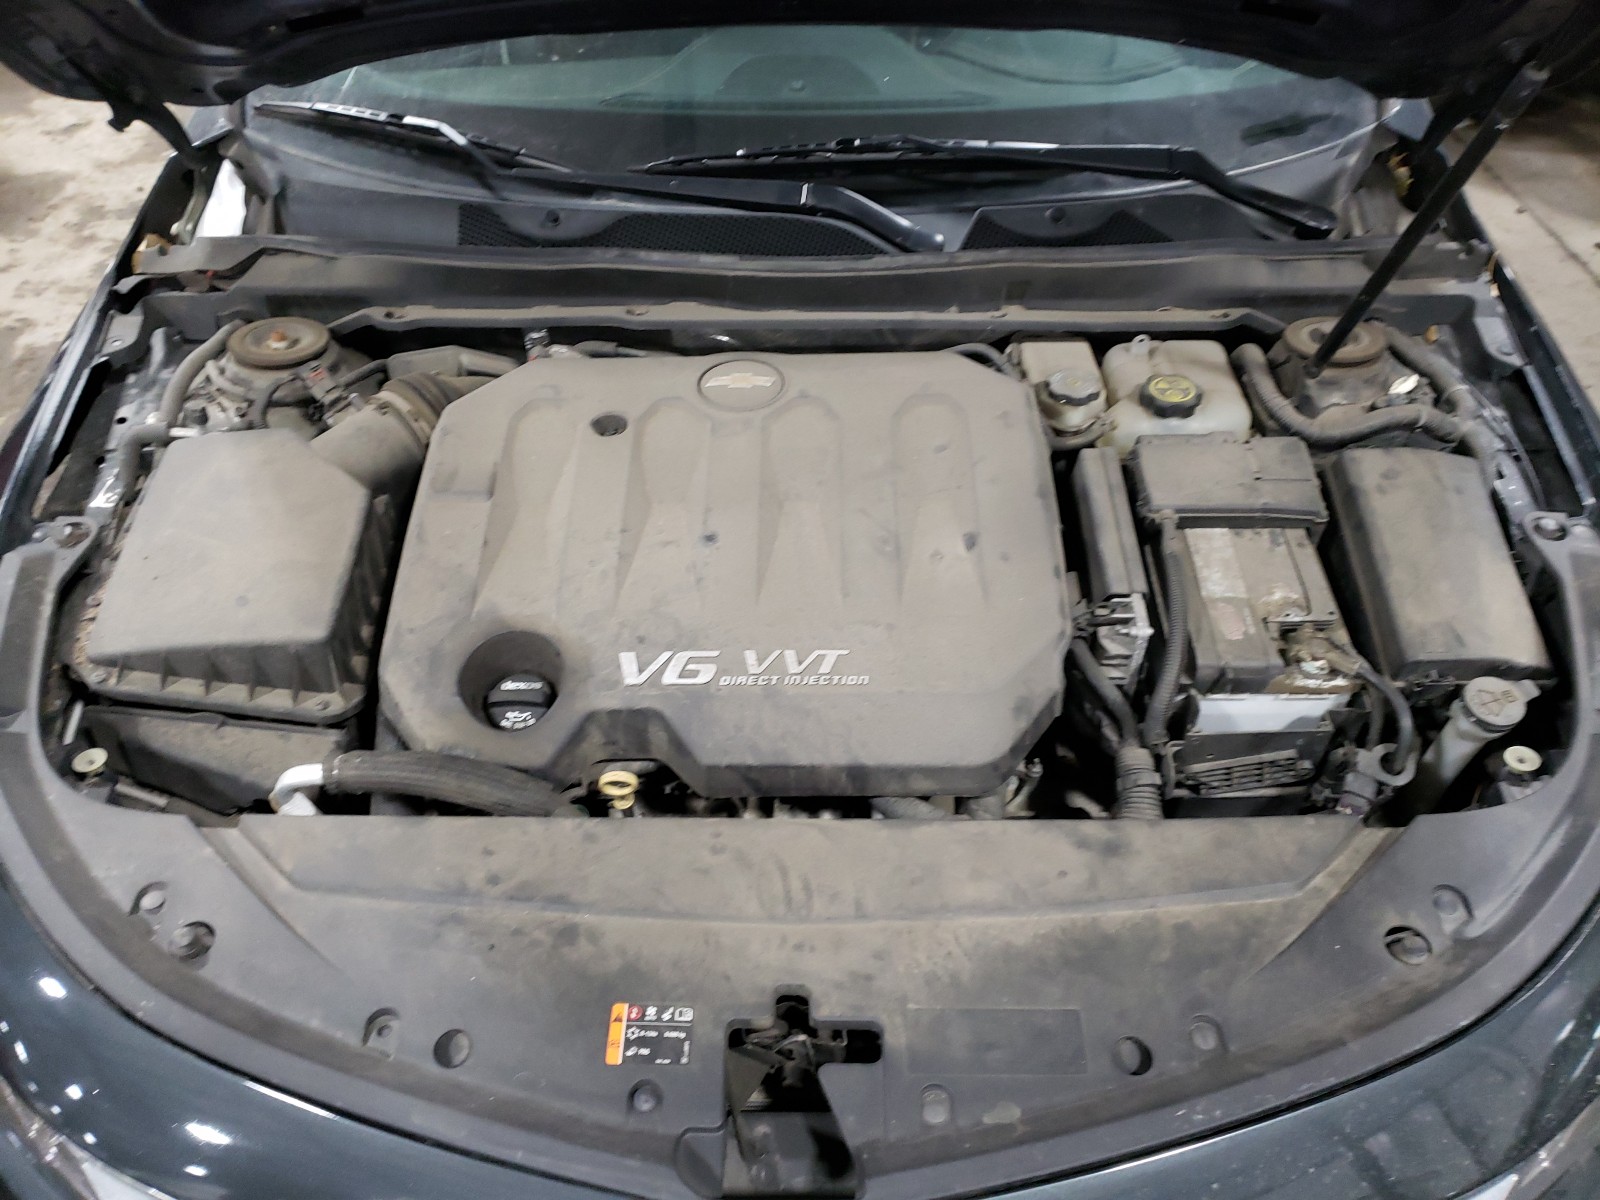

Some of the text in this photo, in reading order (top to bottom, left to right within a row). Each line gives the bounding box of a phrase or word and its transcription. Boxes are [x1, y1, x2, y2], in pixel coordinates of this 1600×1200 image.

[618, 649, 851, 685] V6 VVT
[718, 675, 870, 686] DIRECT INJECTION
